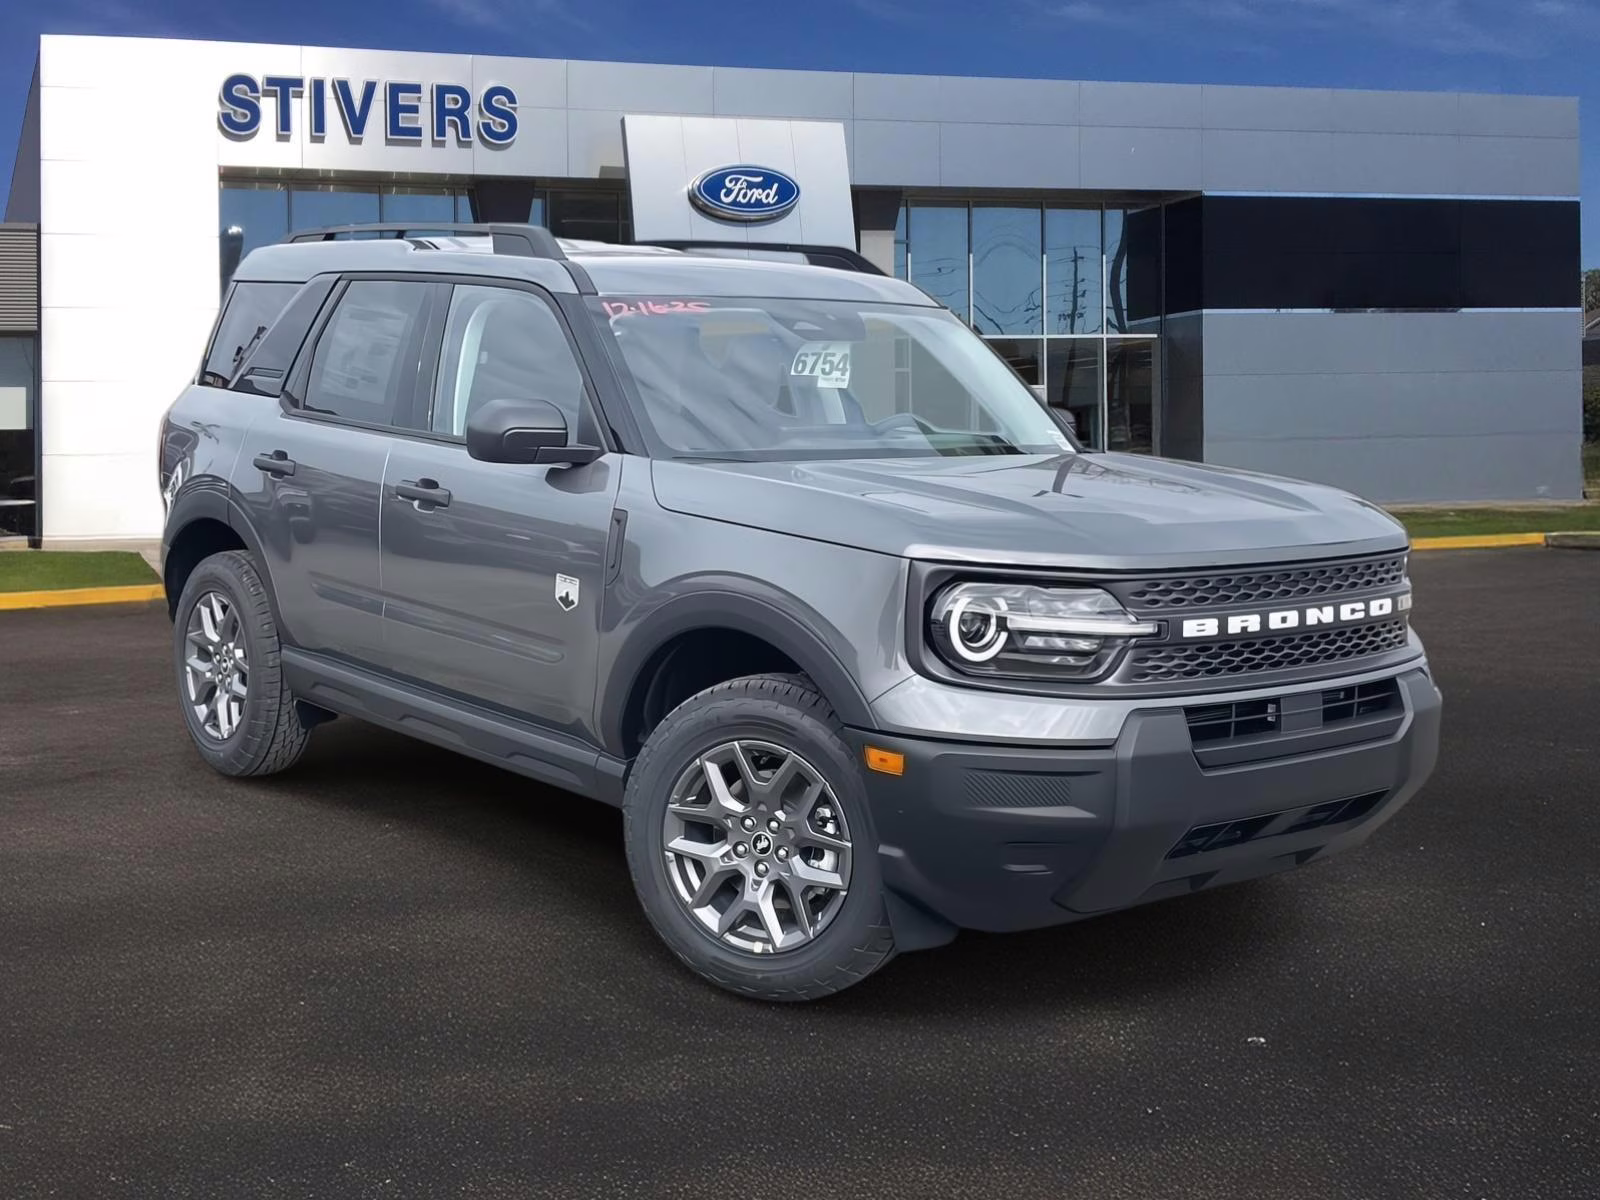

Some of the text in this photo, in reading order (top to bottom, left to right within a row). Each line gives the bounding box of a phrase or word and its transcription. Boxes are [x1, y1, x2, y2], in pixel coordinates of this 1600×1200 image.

[218, 73, 519, 149] STIVERS
[720, 174, 779, 204] Ford
[793, 351, 849, 377] 6754
[1182, 597, 1393, 638] BRONCO
